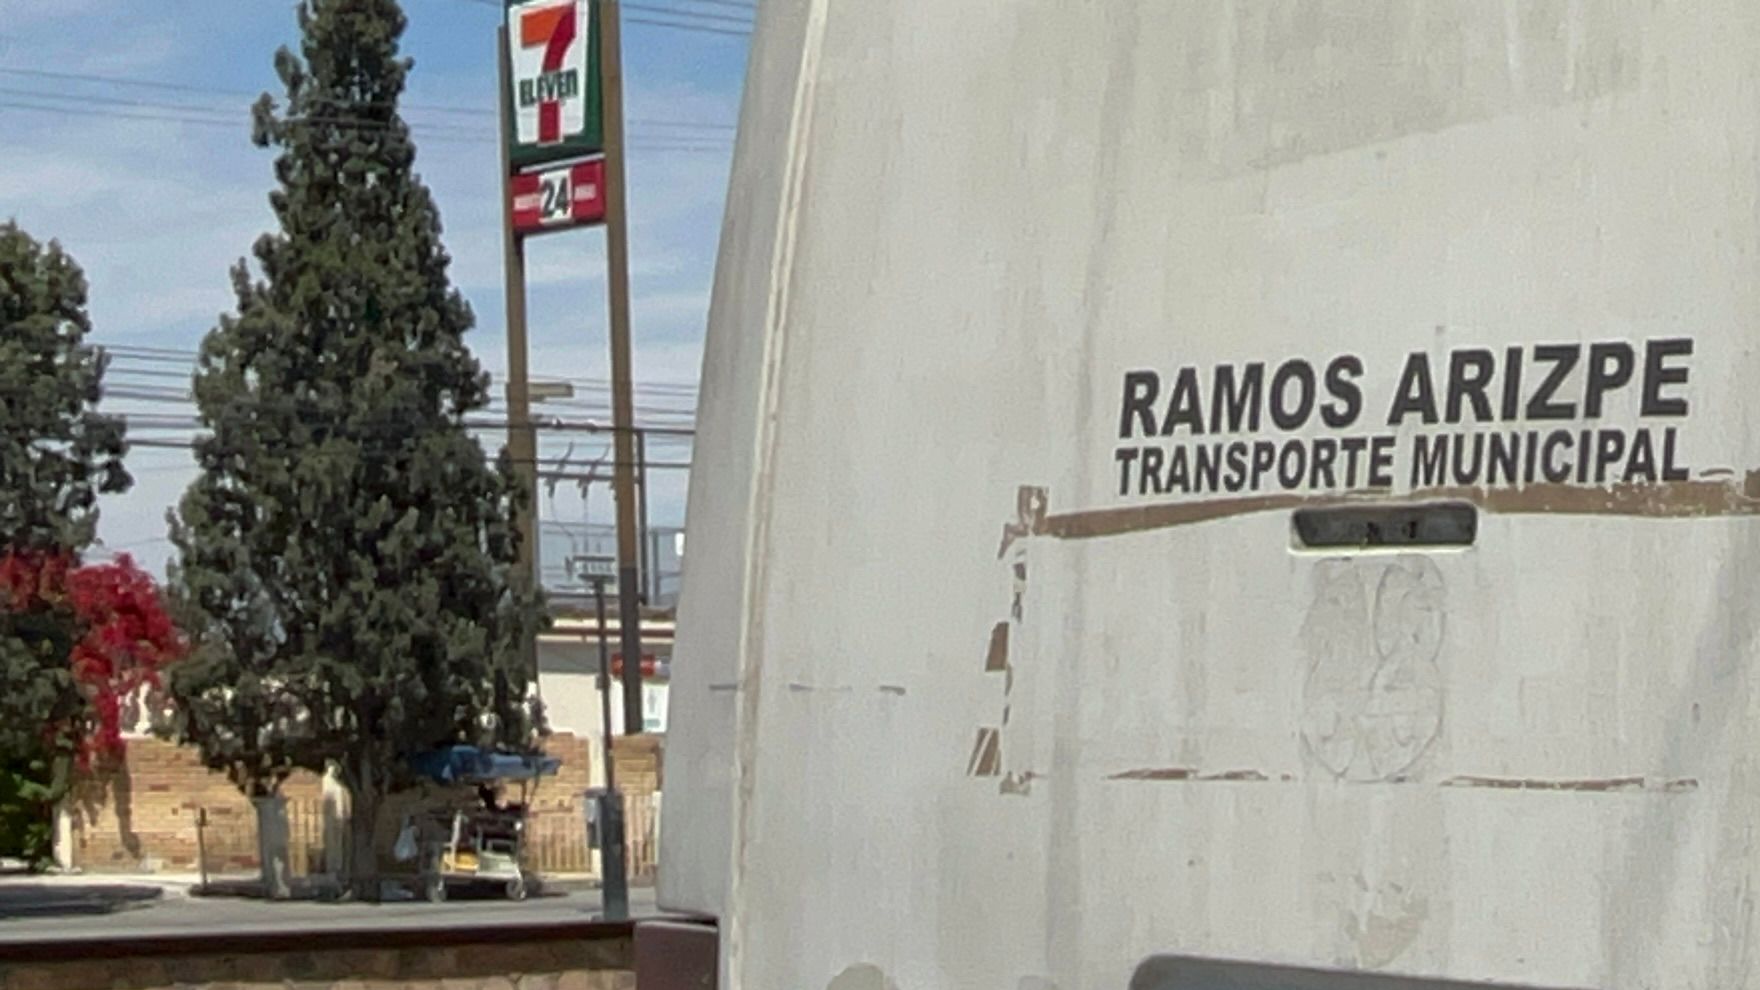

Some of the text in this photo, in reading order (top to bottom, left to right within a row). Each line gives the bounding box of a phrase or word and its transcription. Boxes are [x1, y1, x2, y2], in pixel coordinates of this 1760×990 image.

[520, 4, 577, 143] 7
[541, 177, 569, 217] 24
[1119, 338, 1693, 438] RAMOS ARIZPE
[1115, 427, 1690, 496] TRANSPORTE MUNICIPAL
